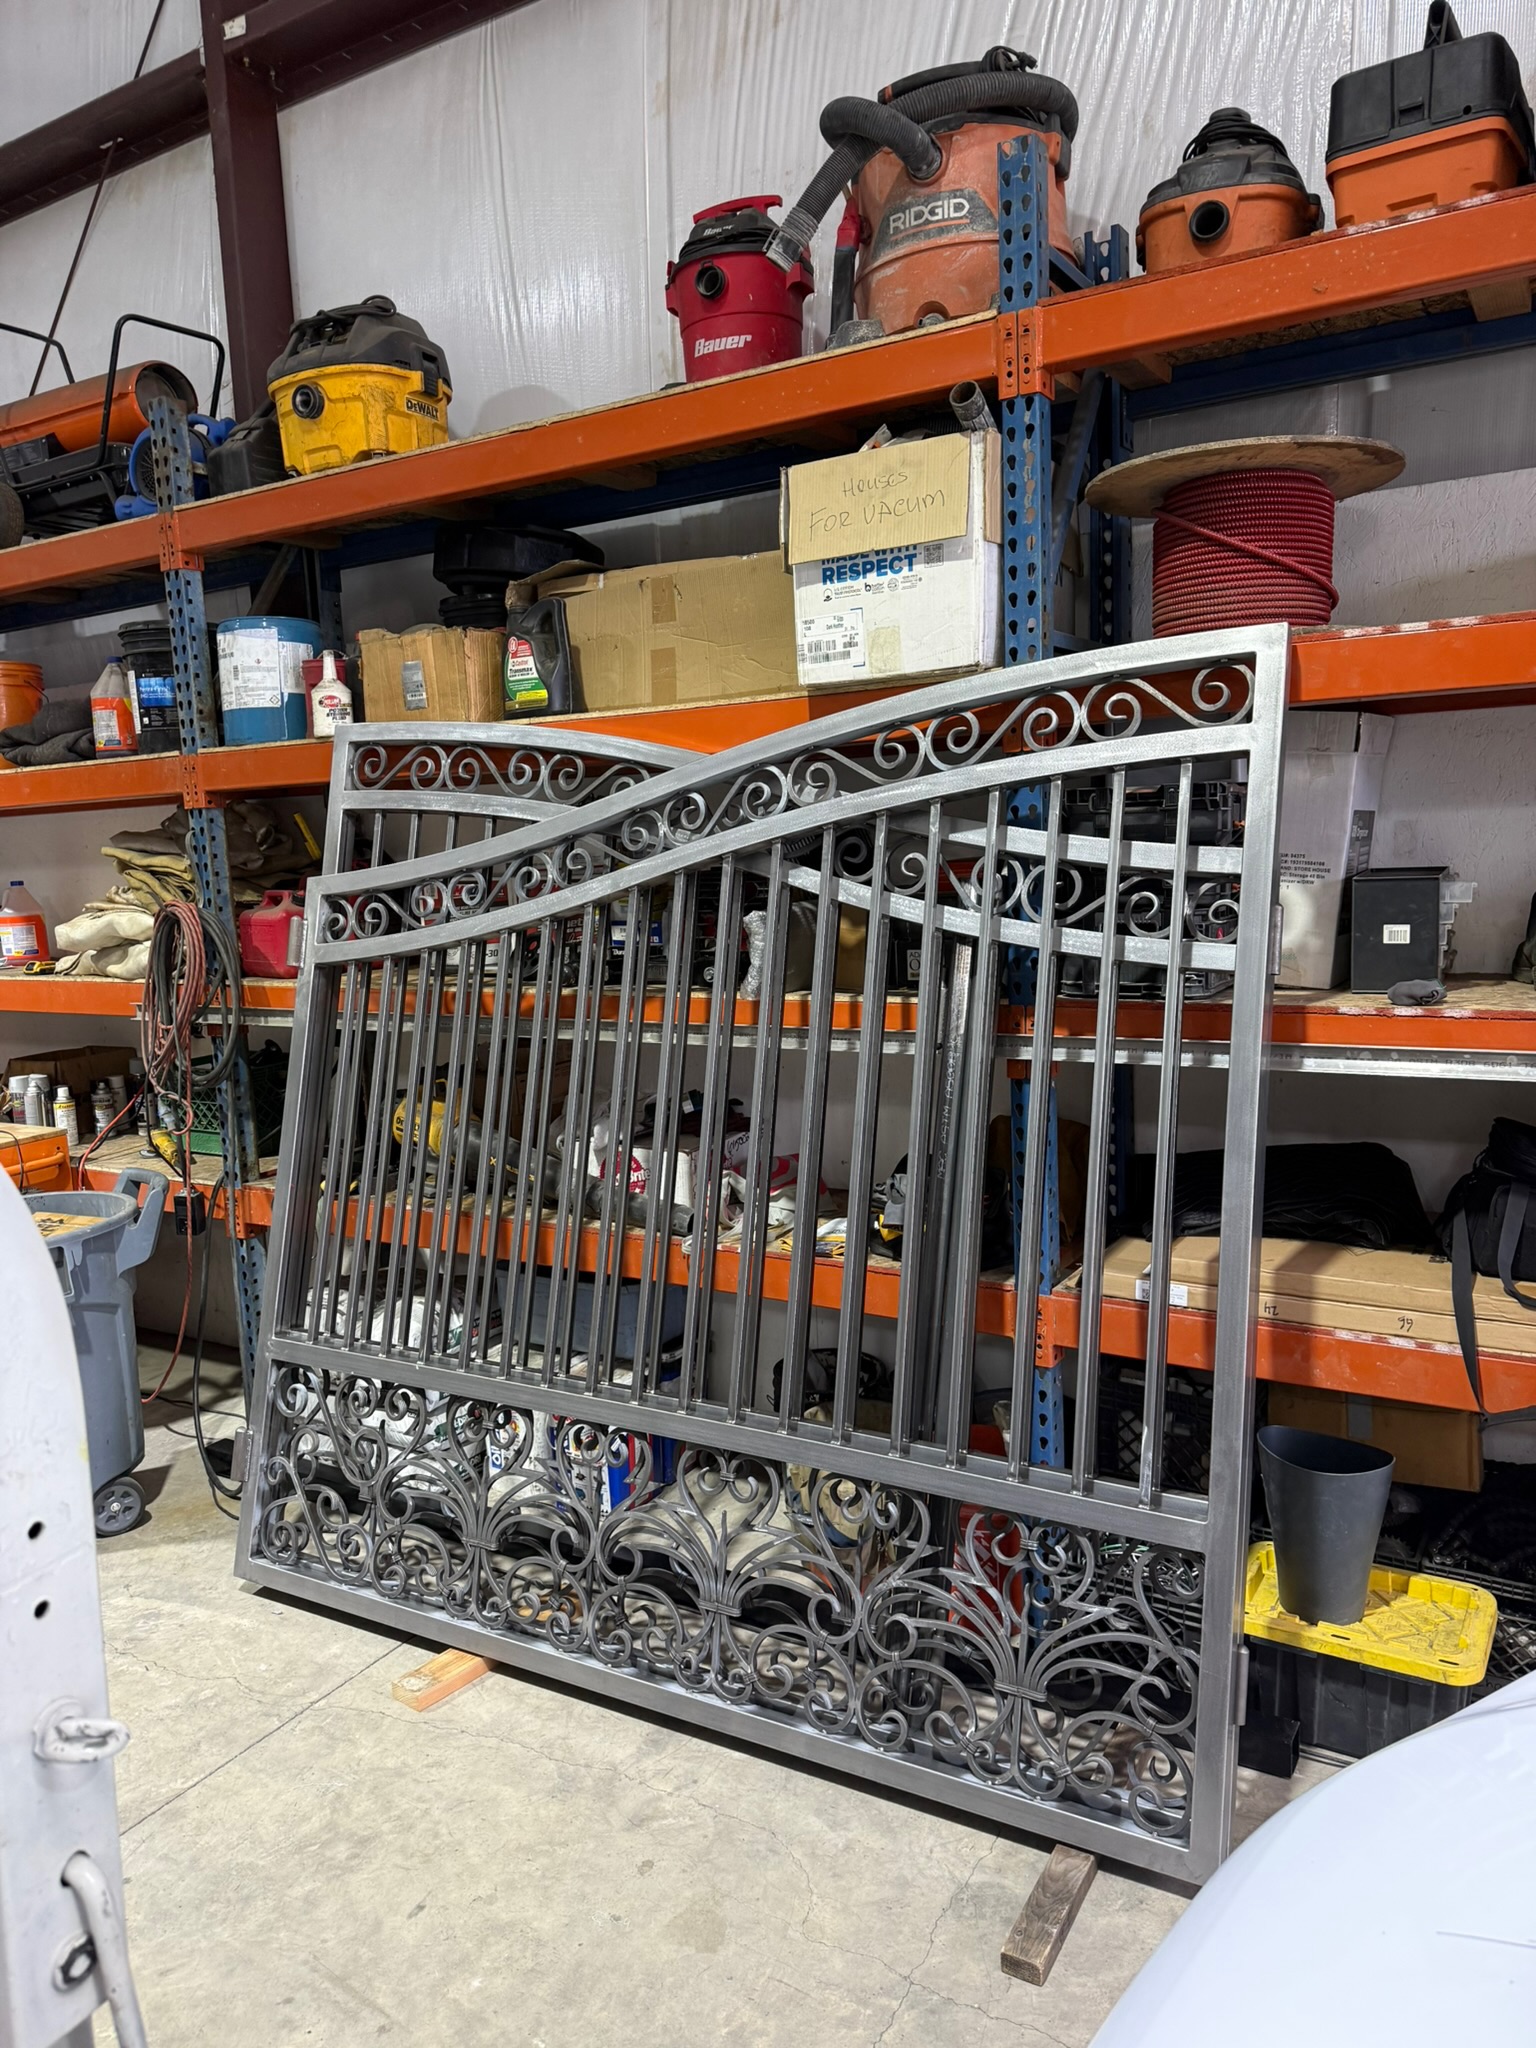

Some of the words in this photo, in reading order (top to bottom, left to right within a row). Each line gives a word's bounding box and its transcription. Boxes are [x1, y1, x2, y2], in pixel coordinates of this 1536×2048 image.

[889, 197, 970, 235] RIDGID
[694, 334, 752, 358] Bauer
[809, 507, 853, 542] FOR
[863, 489, 945, 525] VACUM
[822, 553, 917, 586] RESPECT
